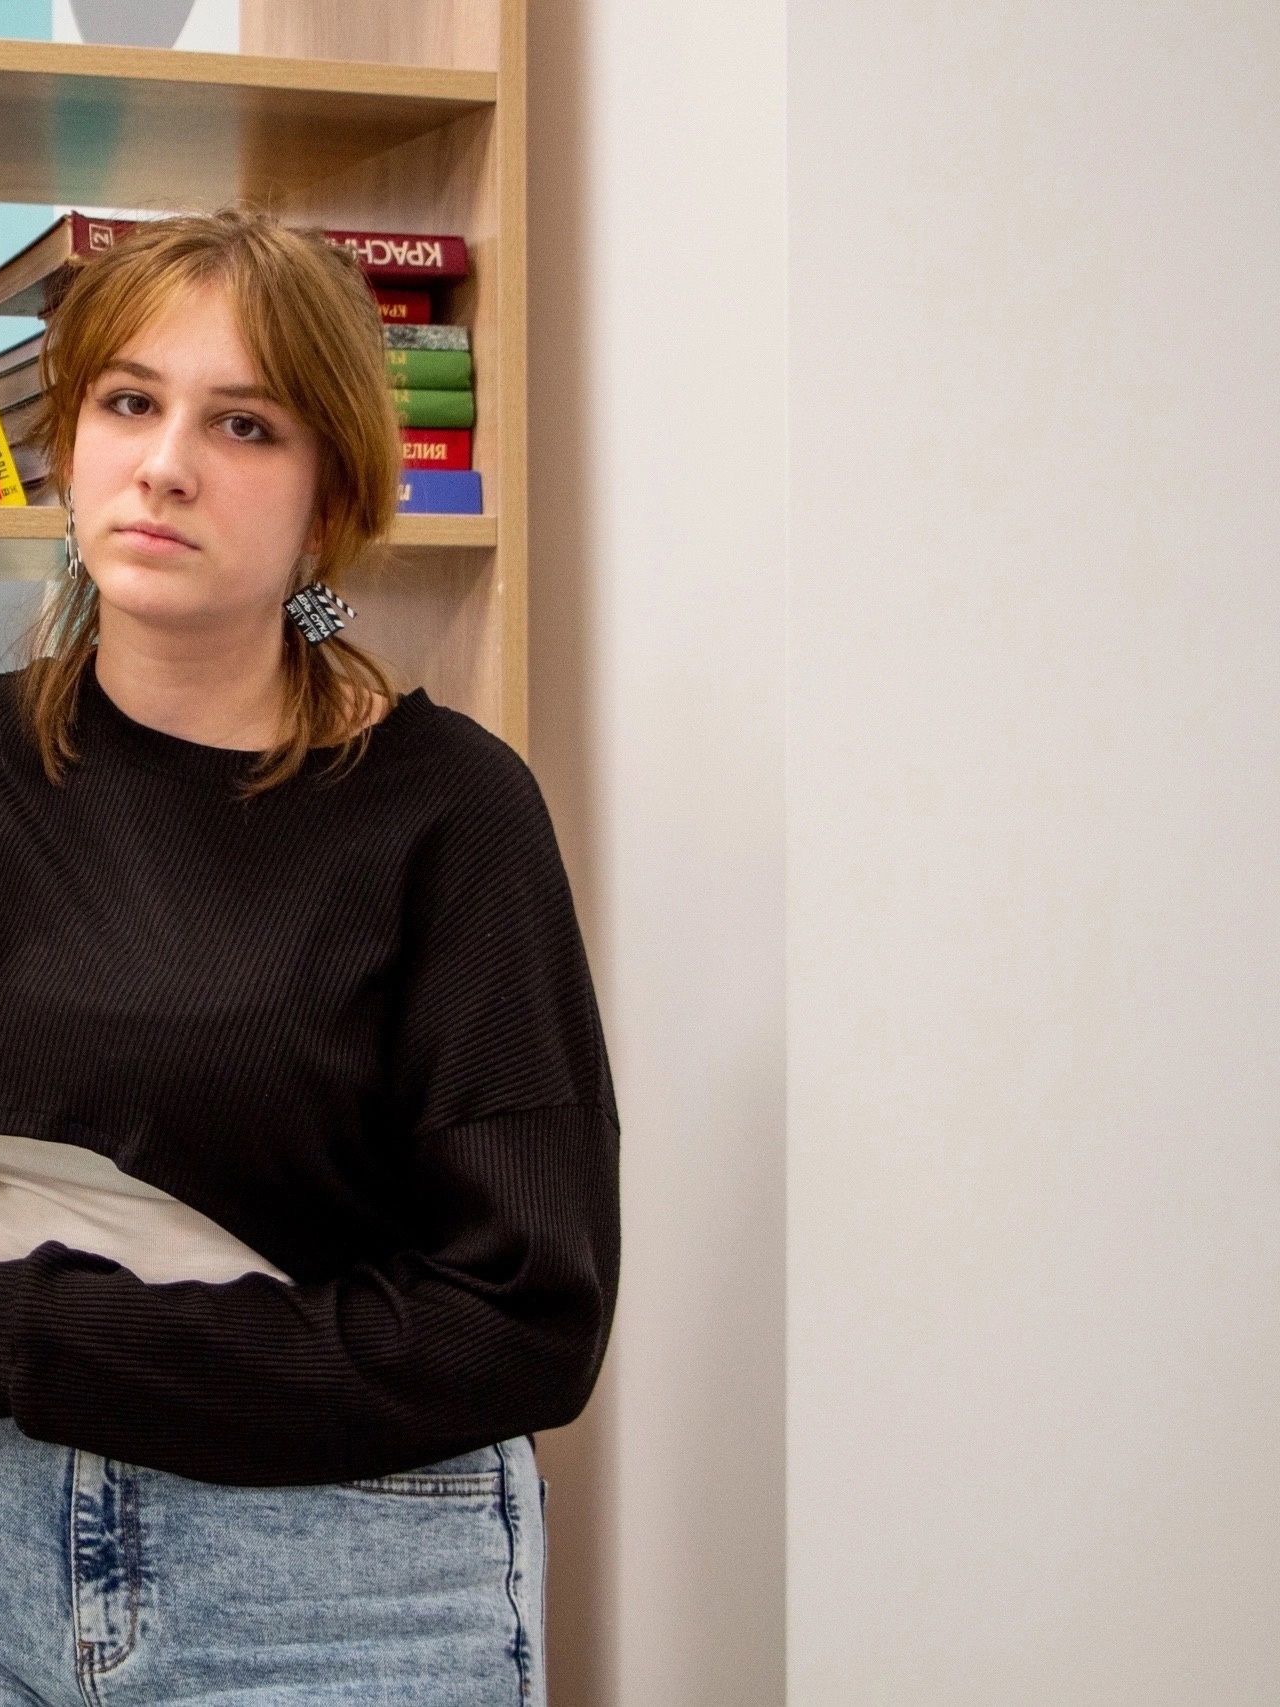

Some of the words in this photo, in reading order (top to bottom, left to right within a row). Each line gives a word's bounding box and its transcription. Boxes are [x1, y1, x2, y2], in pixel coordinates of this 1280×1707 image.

[325, 237, 443, 268] КРАСН
[402, 442, 448, 461] ЕЛИЯ
[310, 613, 331, 638] СУРКА
